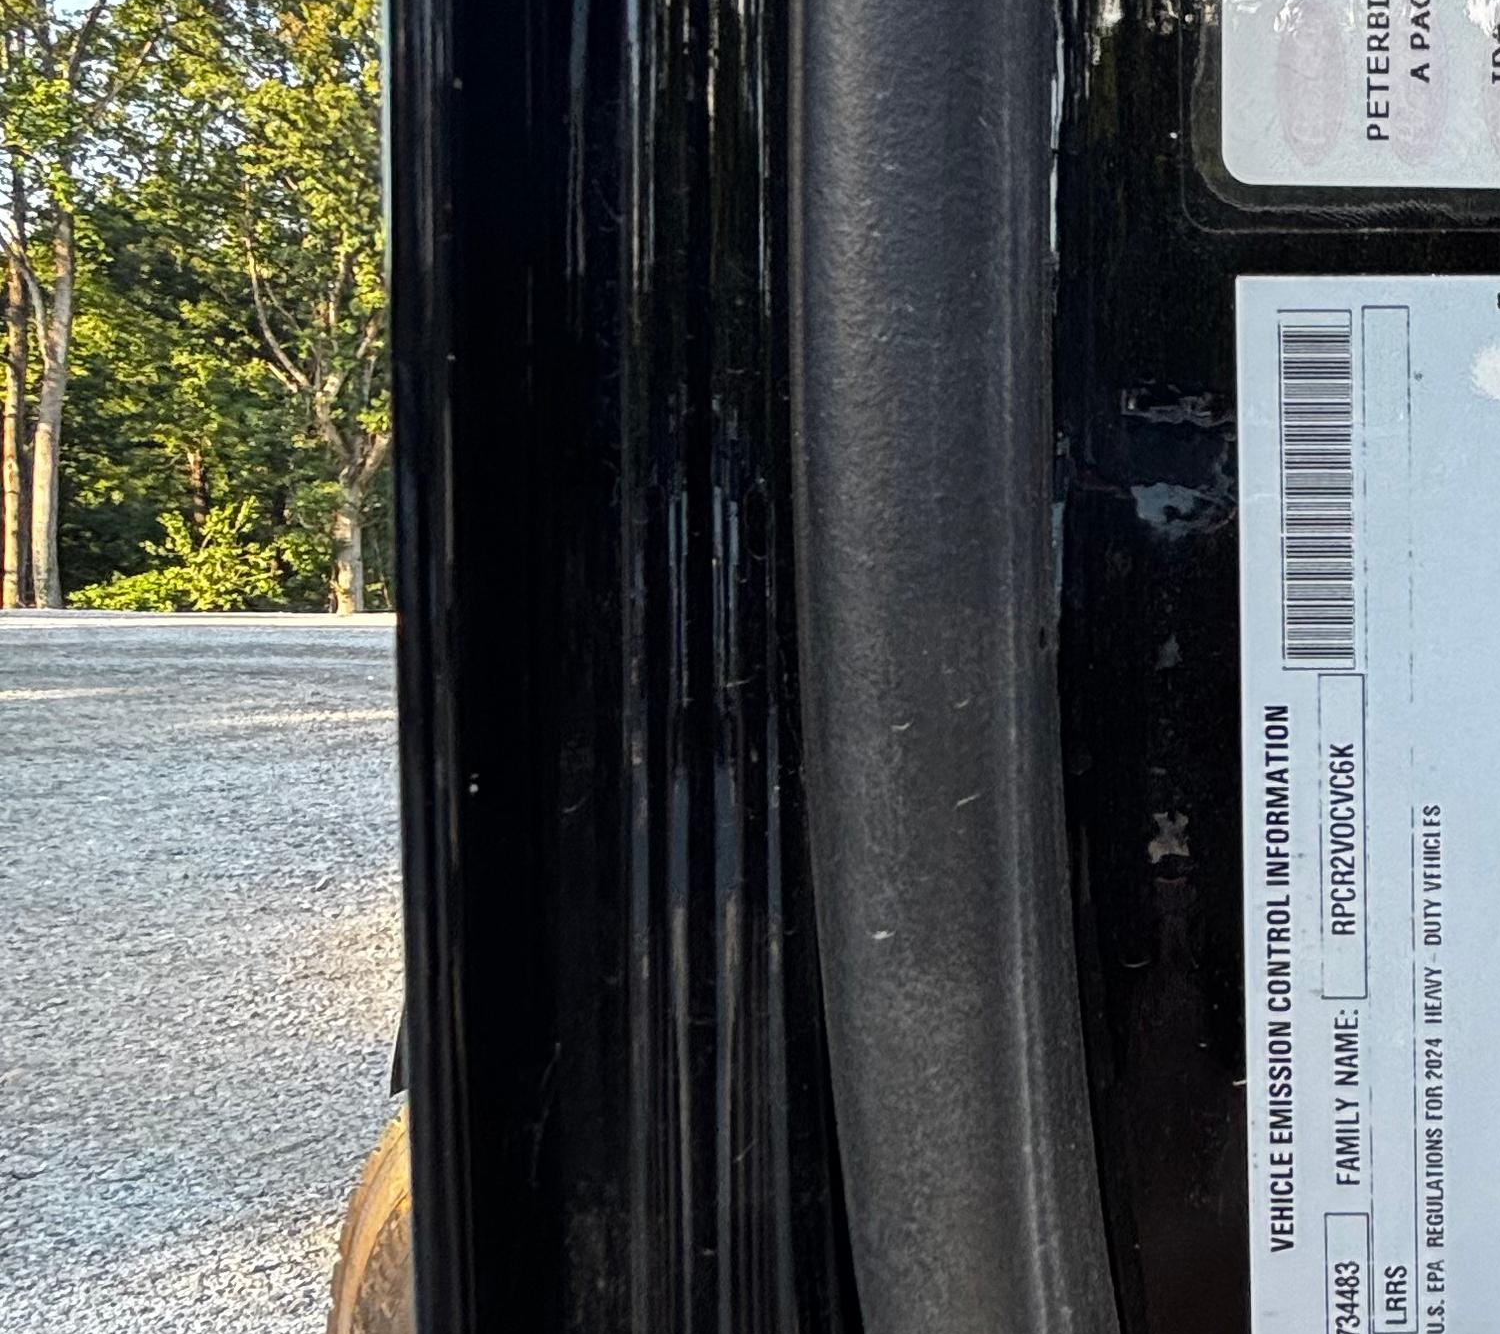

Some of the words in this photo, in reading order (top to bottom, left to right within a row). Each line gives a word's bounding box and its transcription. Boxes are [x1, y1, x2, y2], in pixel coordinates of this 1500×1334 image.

[1409, 61, 1431, 83] A
[1263, 704, 1290, 886] INFORMATION
[1422, 803, 1443, 892] VEHICLES
[1266, 893, 1292, 1012] CONTROL
[1423, 897, 1443, 945] DUTY
[1267, 1020, 1294, 1144] EMISSION
[1333, 1007, 1359, 1086] NAME:
[1423, 1036, 1444, 1080] 2024
[1334, 1096, 1361, 1186] FAMILY
[1423, 1084, 1444, 1121] FOR
[1269, 1151, 1295, 1252] VEHICLE
[1424, 1126, 1445, 1248] REGULATIONS
[1384, 1263, 1408, 1325] LRRS
[1425, 1257, 1445, 1292] EPA
[1426, 1298, 1445, 1334] U.S.
